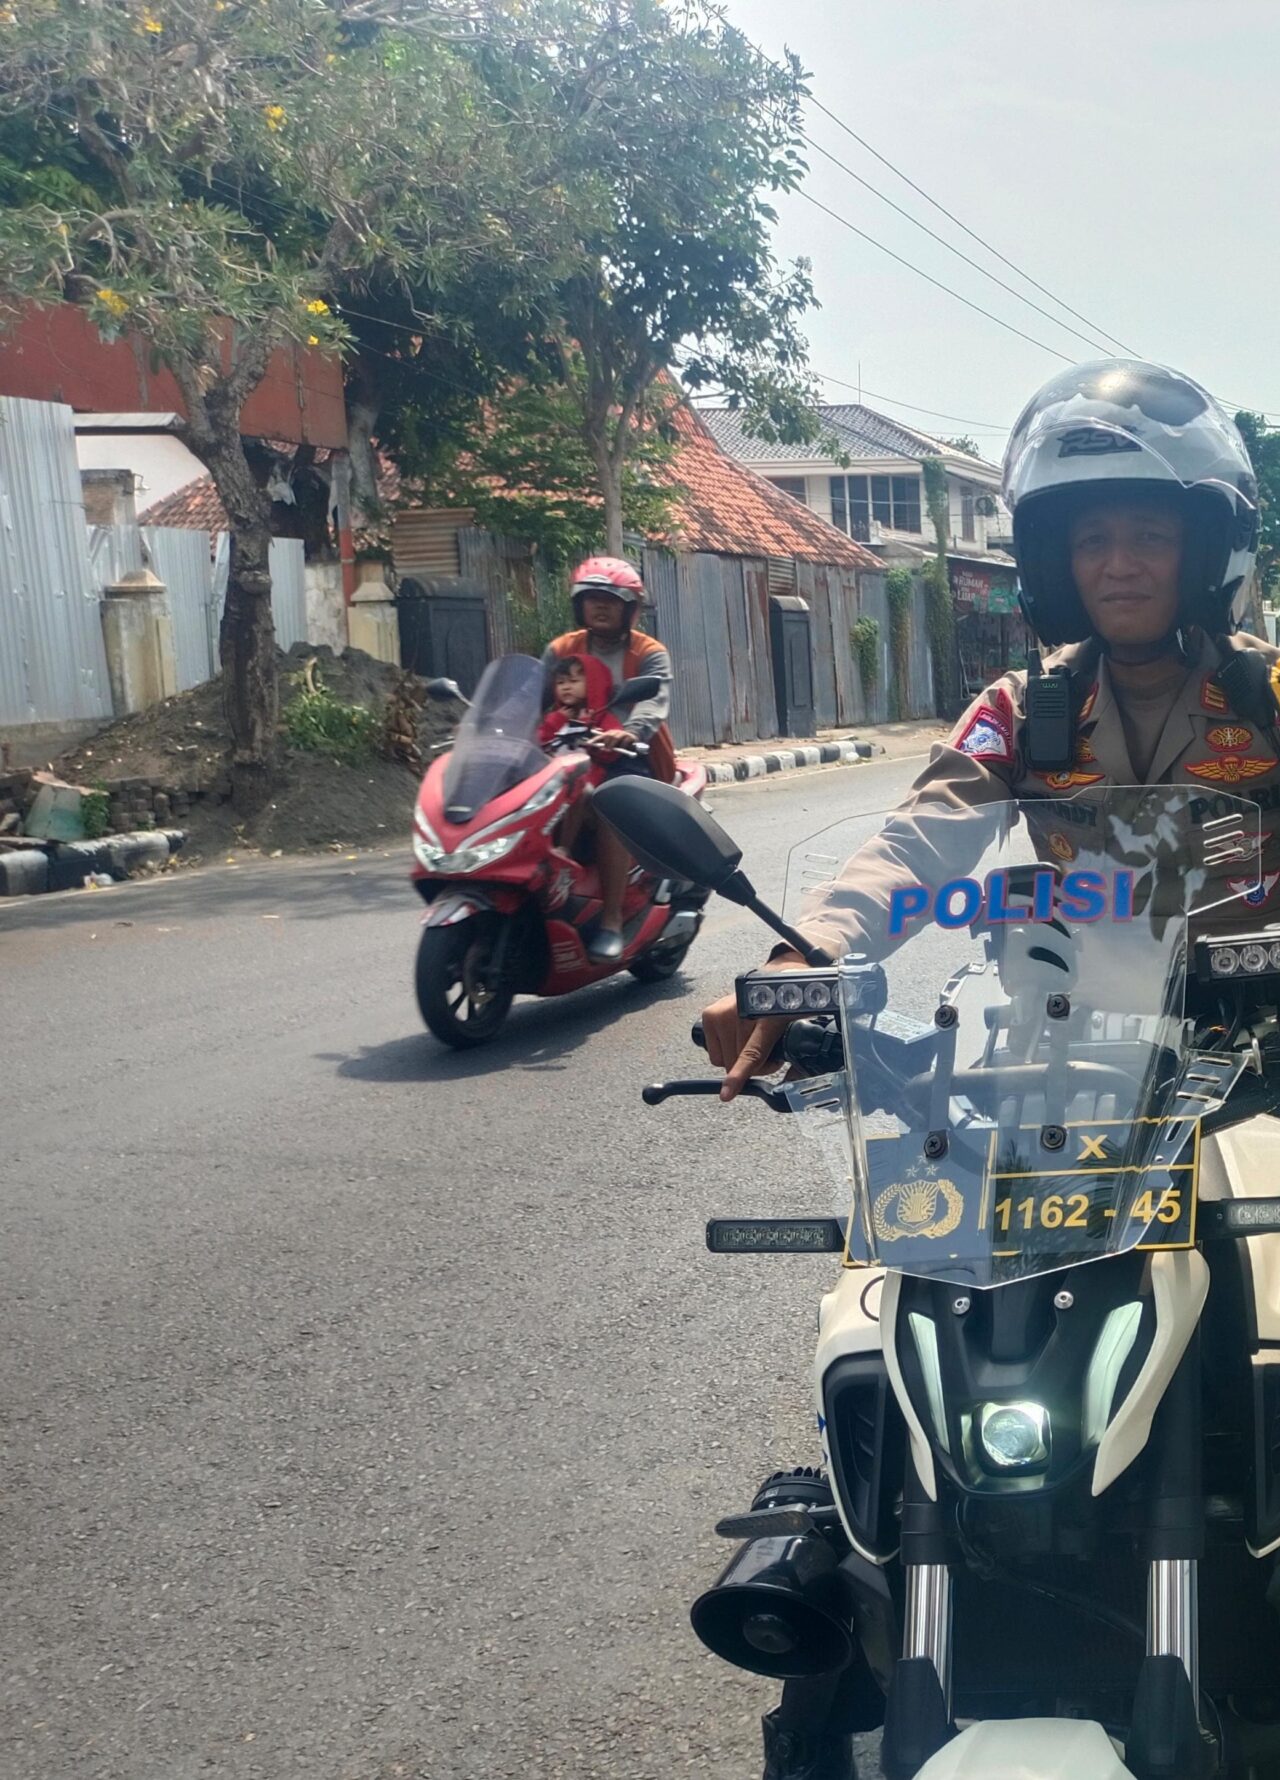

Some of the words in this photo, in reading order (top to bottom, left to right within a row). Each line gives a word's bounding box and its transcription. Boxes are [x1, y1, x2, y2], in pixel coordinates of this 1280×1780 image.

[1188, 786, 1280, 824] POLRI
[888, 869, 1135, 939] POLISI
[1076, 1134, 1108, 1161] X
[995, 1195, 1089, 1232] 1162
[1131, 1189, 1181, 1225] 45
